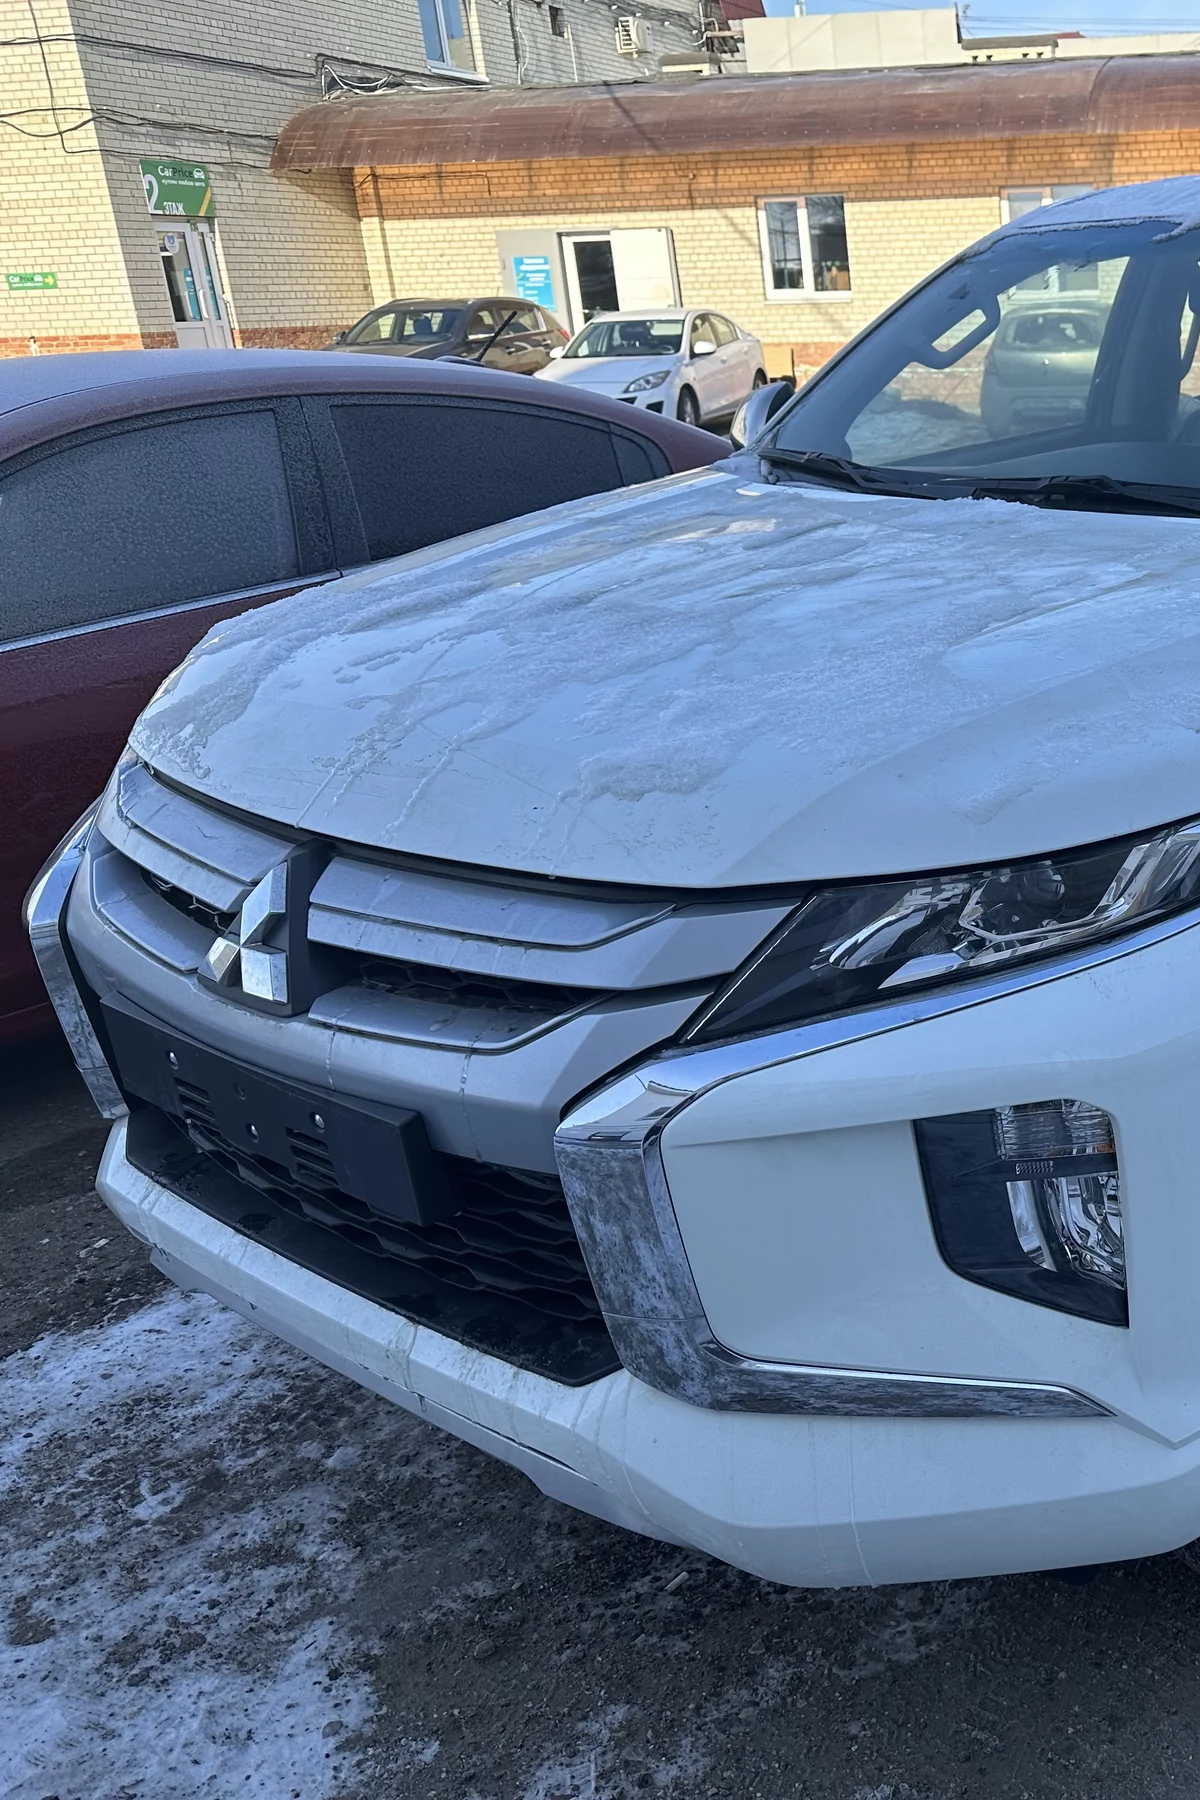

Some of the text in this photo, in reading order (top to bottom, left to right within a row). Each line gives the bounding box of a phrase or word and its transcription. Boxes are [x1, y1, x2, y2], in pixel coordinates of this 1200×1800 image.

[158, 165, 194, 179] CarPrice
[143, 174, 186, 215] 2 ЭТАЖ
